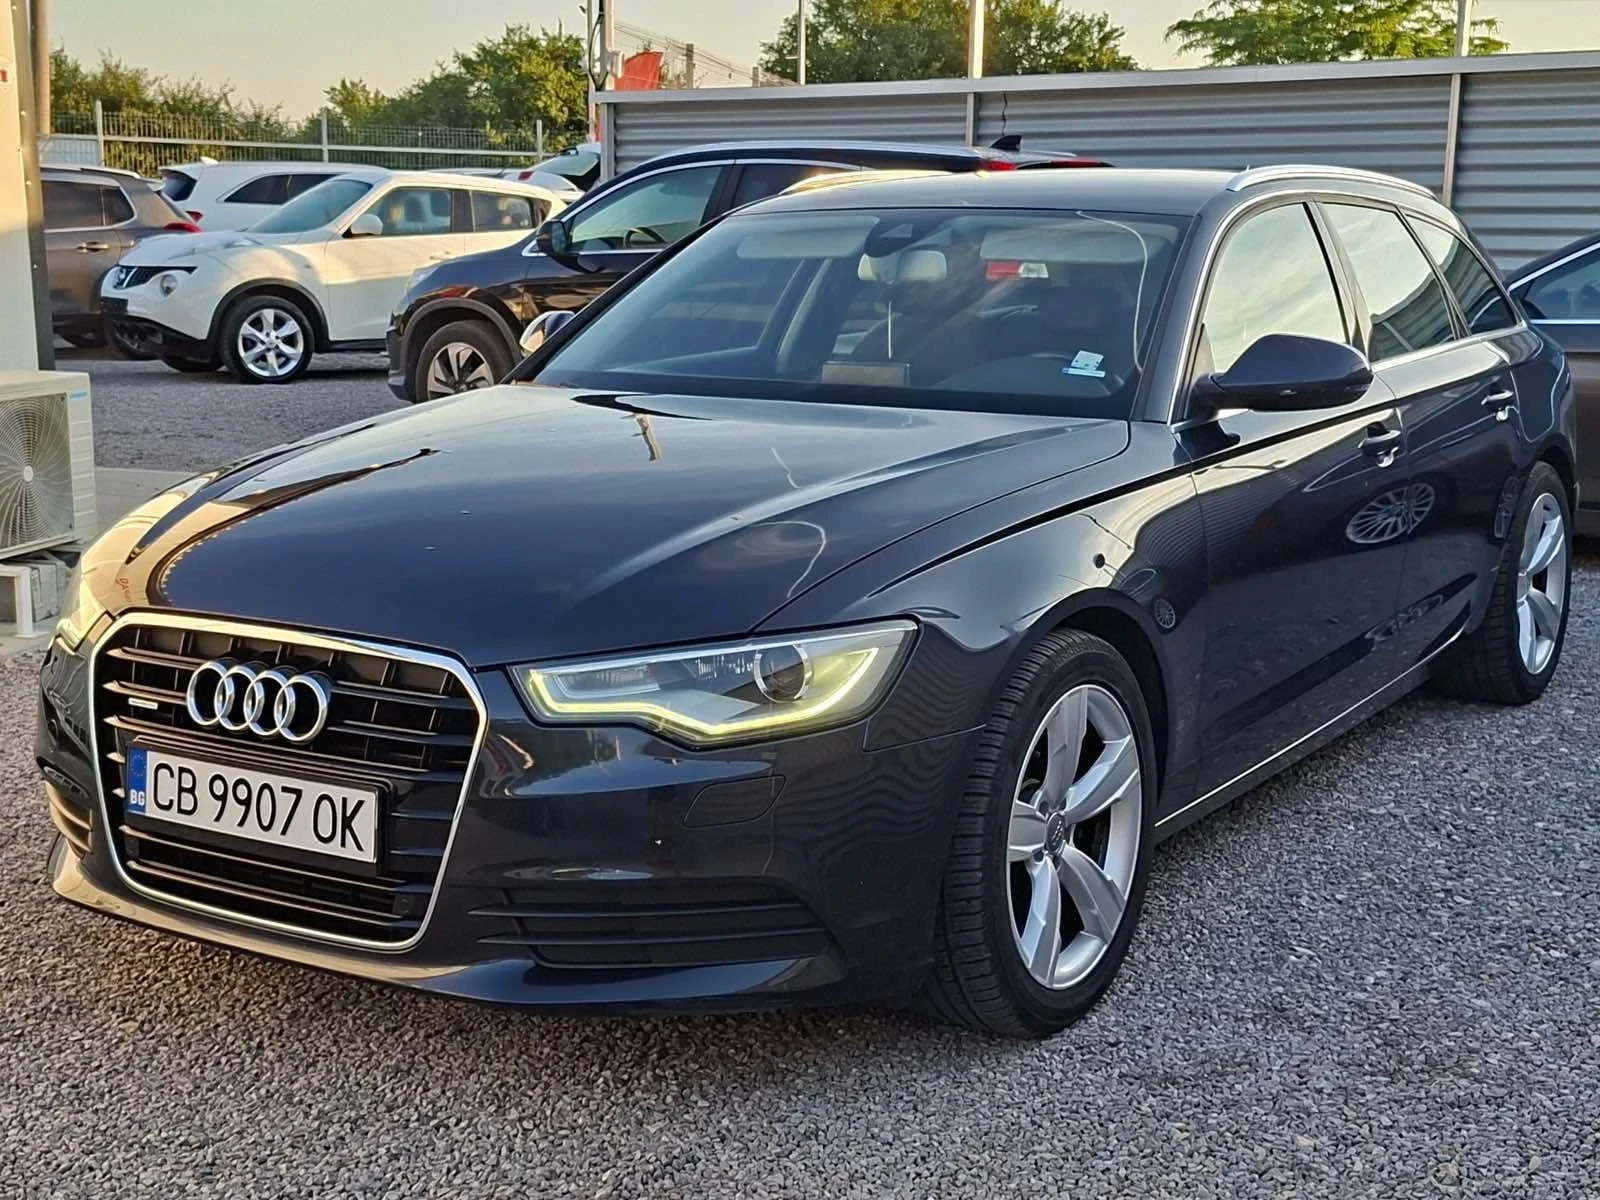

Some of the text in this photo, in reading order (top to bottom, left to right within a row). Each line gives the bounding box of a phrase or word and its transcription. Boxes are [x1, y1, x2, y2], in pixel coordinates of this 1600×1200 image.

[130, 788, 145, 806] BG
[153, 762, 365, 852] CB 9907 OK
